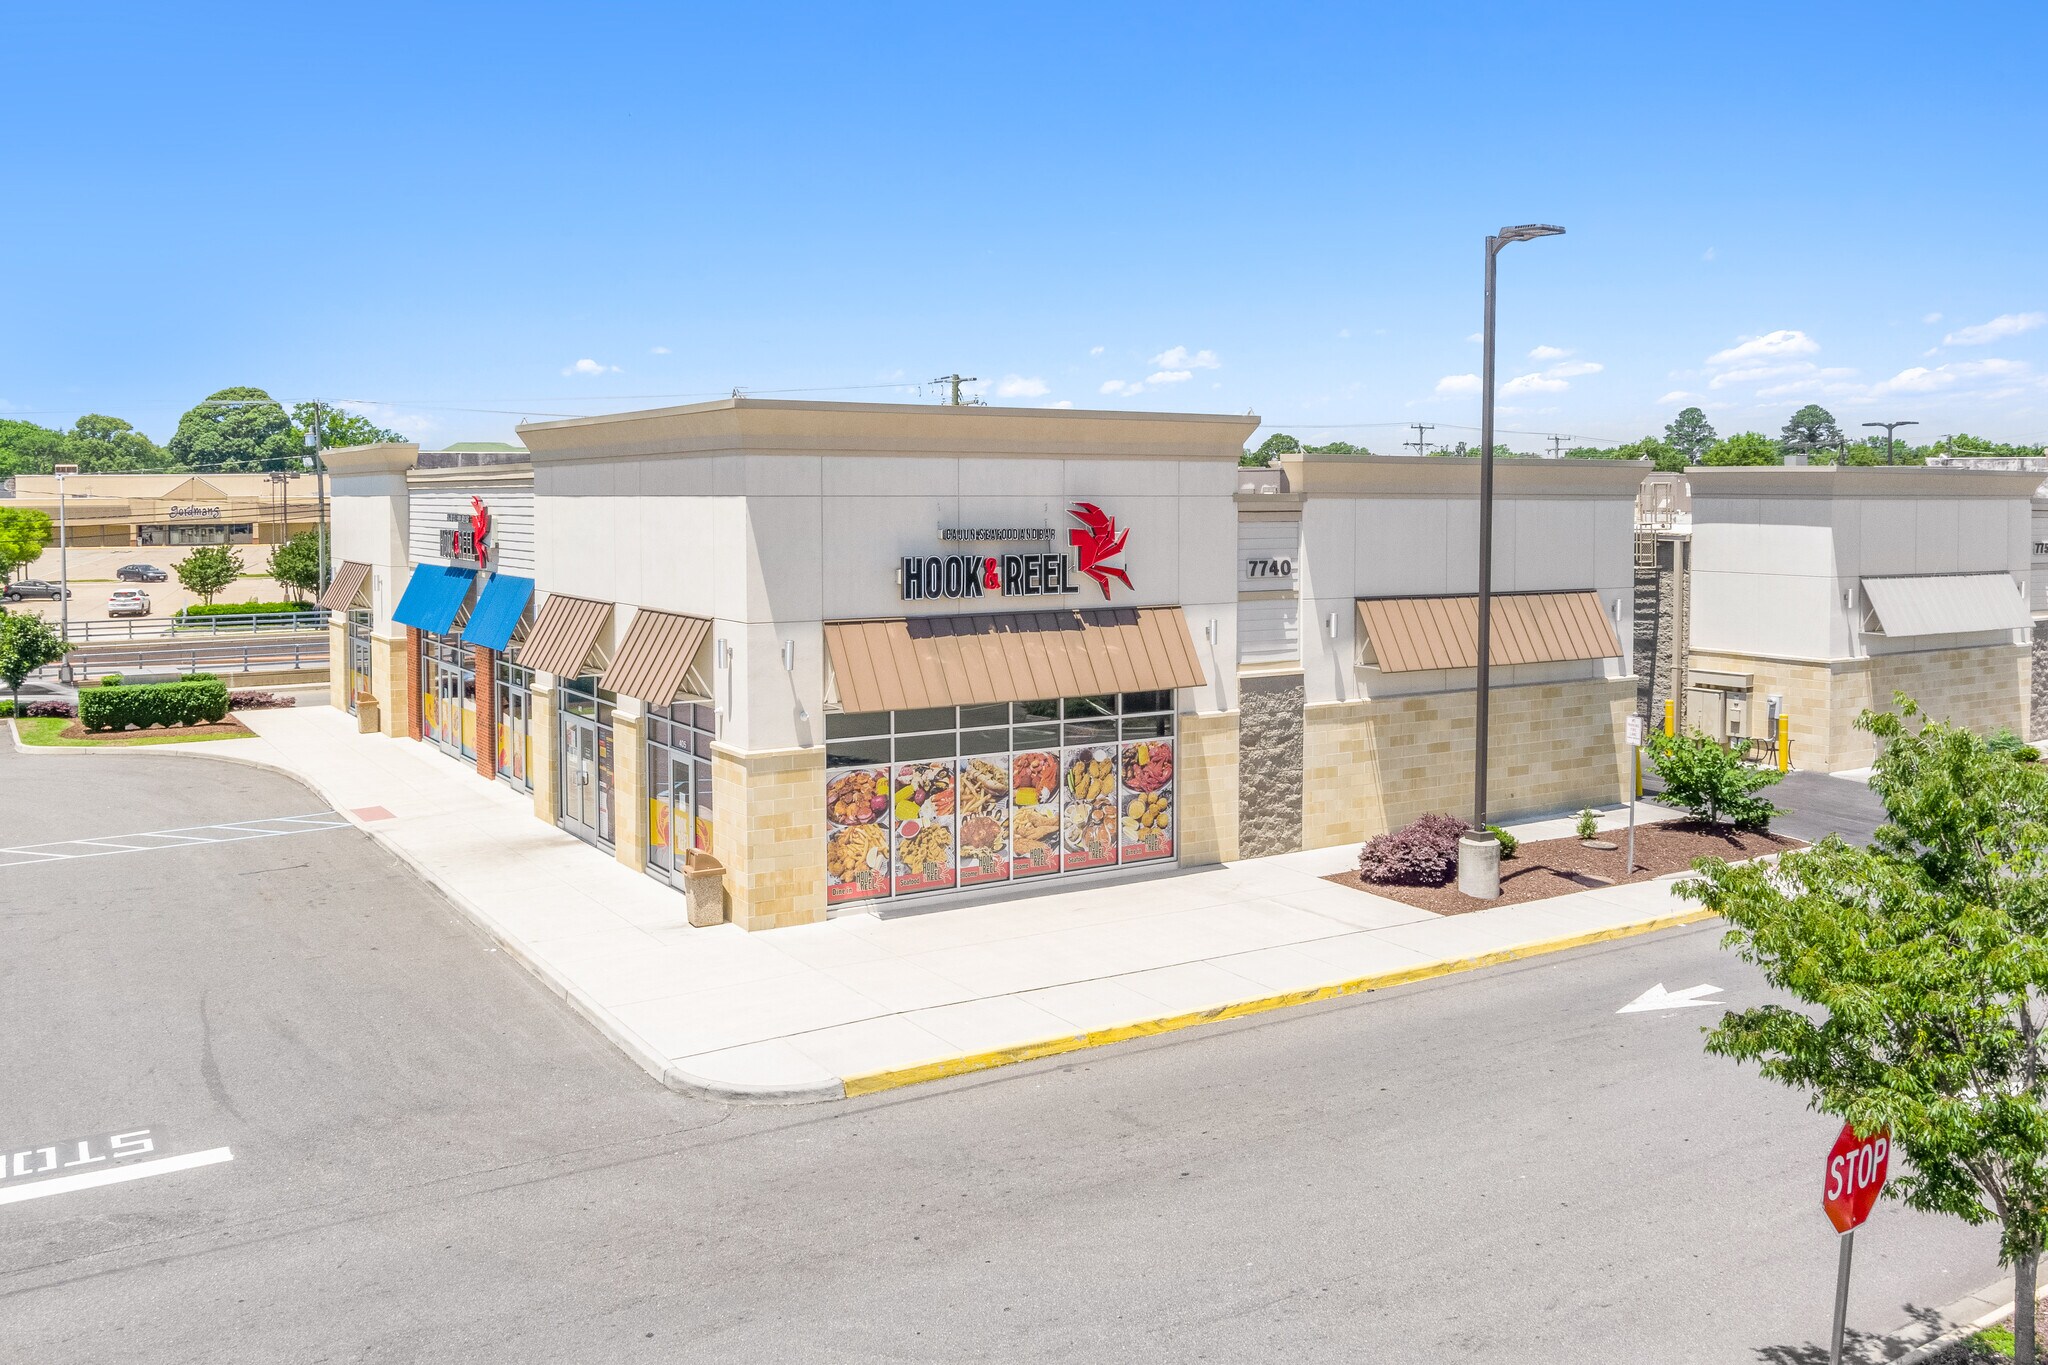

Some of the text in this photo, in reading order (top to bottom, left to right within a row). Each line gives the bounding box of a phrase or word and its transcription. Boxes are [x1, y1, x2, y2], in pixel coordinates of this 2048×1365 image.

[944, 528, 1056, 541] CAJUN SEAFOOD AND BAR
[1249, 560, 1291, 577] 7740
[923, 861, 938, 874] HOOK
[856, 870, 873, 883] HOOK
[926, 869, 943, 881] REEL
[860, 878, 876, 891] REEL
[900, 878, 920, 887] Seafood
[0, 1129, 154, 1178] STO
[1827, 1137, 1887, 1201] STOP
